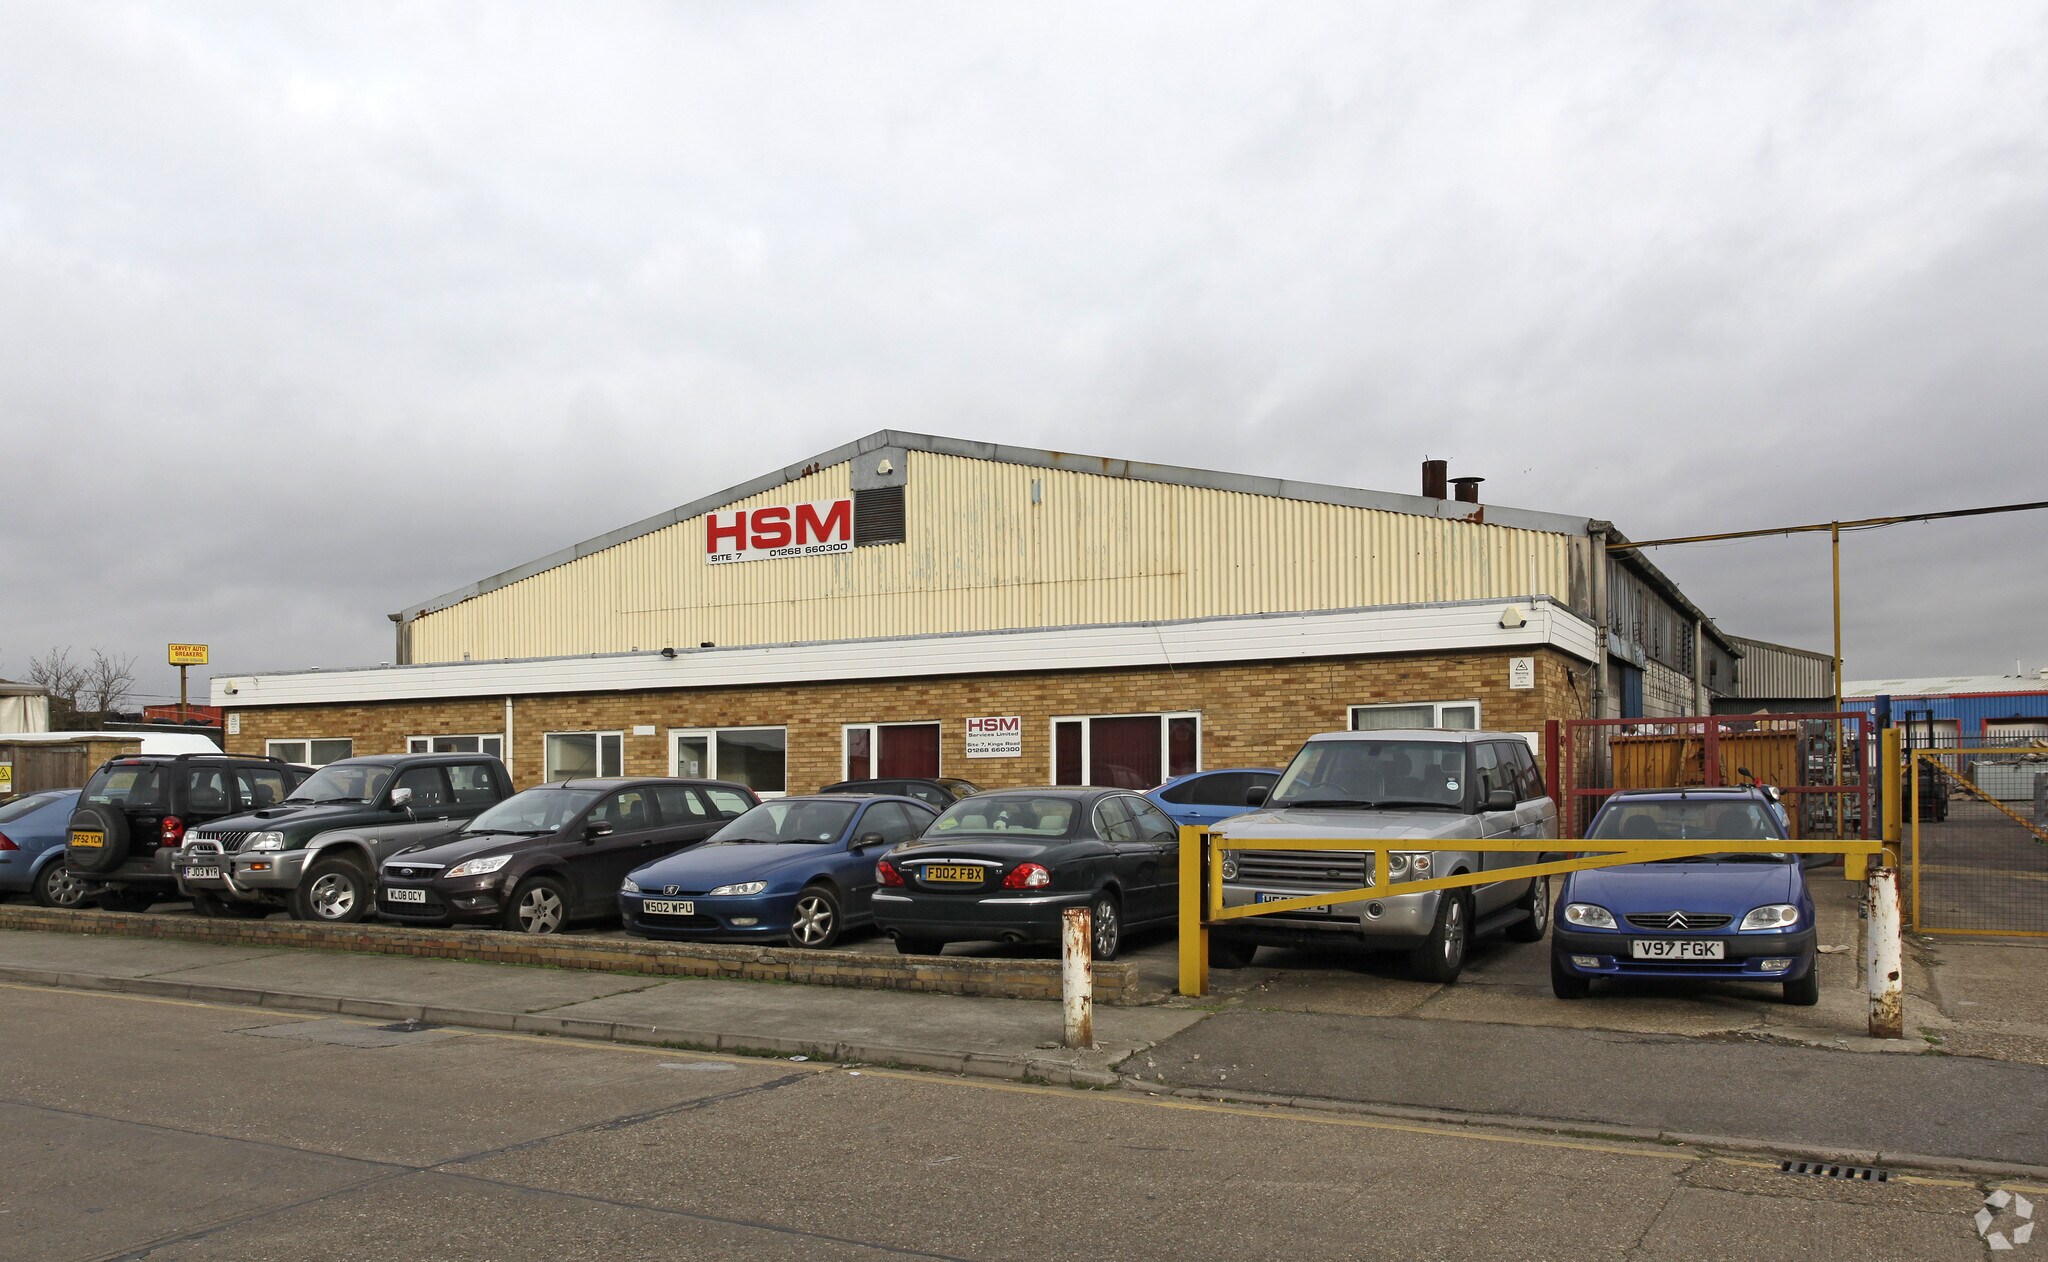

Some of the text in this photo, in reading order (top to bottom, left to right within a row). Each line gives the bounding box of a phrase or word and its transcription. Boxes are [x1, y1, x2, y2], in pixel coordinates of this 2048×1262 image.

[706, 499, 851, 554] HSM
[769, 542, 848, 557] 01268 660300
[711, 552, 743, 562] SITE 7
[968, 717, 1019, 732] HSM
[73, 834, 89, 844] PF52
[187, 867, 204, 877] FJ03
[928, 867, 982, 880] FD02 FBX
[390, 890, 407, 900] WL08
[645, 901, 693, 913] W502 WPU
[1642, 942, 1716, 956] V97 FGK
